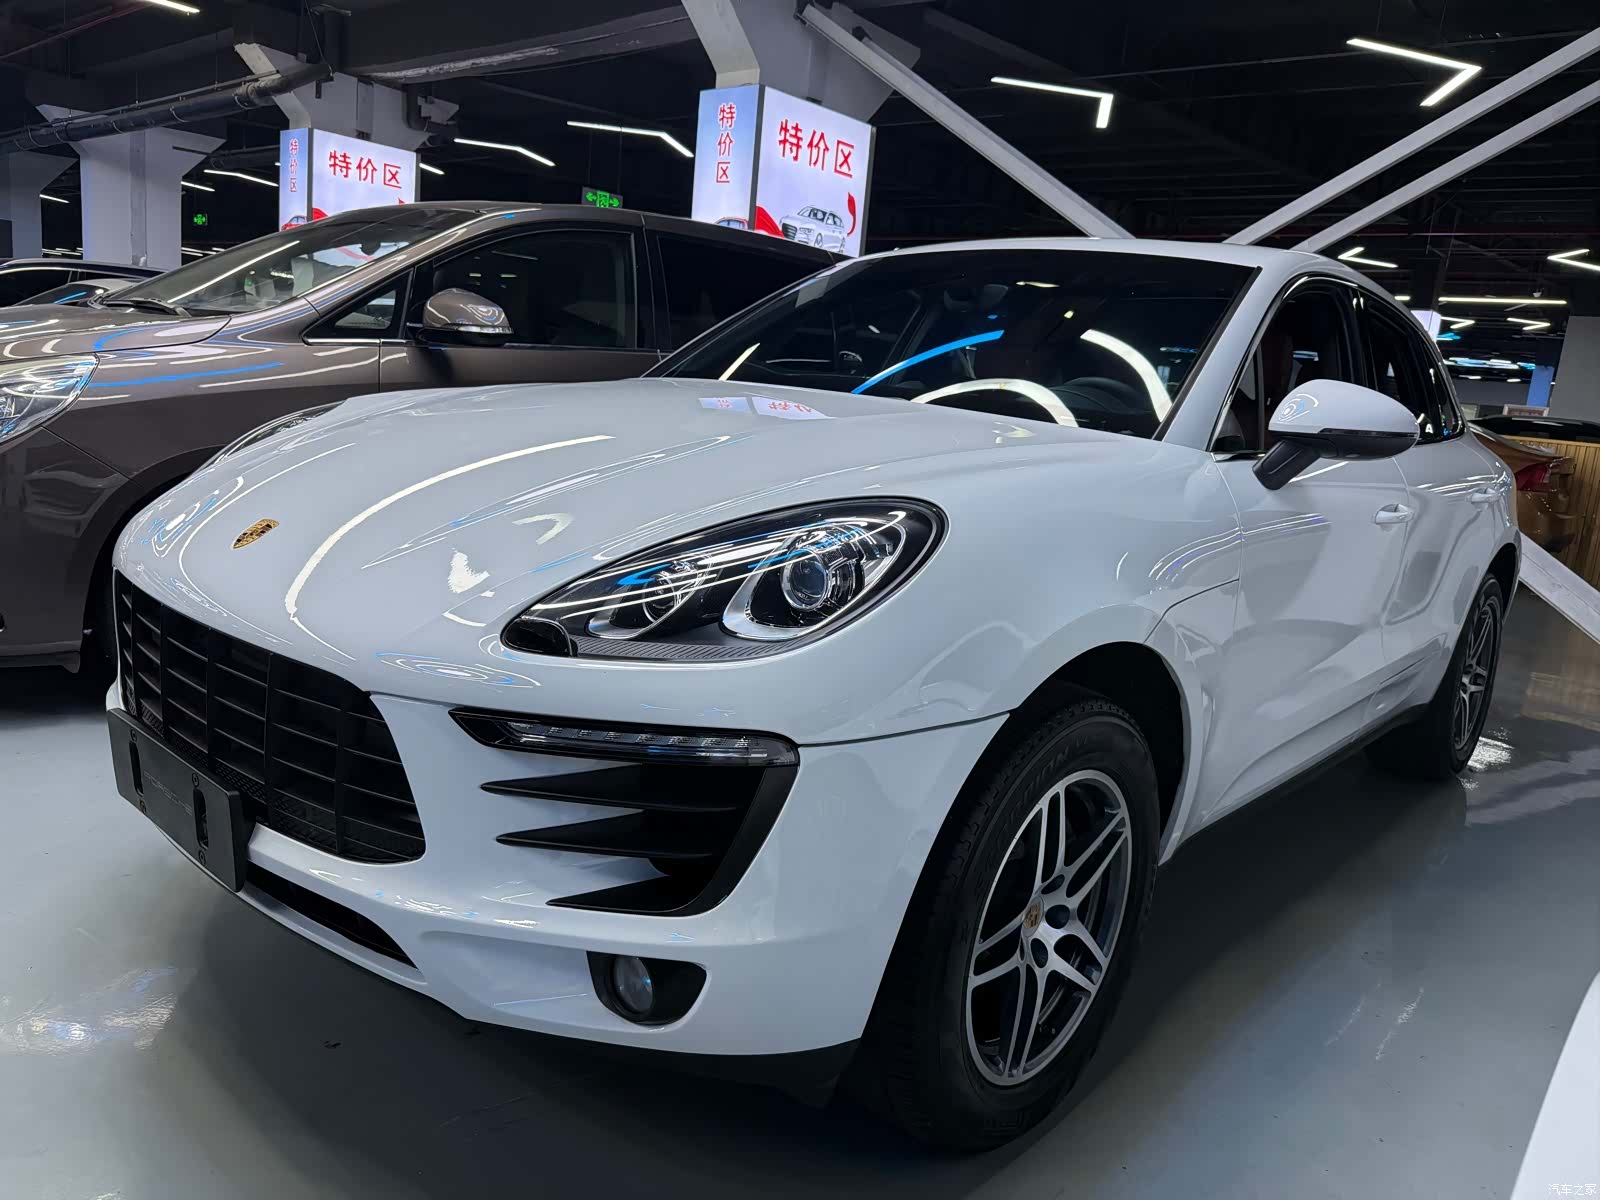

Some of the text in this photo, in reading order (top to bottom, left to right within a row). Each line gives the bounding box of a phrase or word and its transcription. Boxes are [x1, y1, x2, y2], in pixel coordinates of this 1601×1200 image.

[289, 139, 299, 193] 特价区
[328, 149, 402, 189] 特价区
[715, 103, 736, 184] 特价区
[778, 119, 855, 178] 特价区
